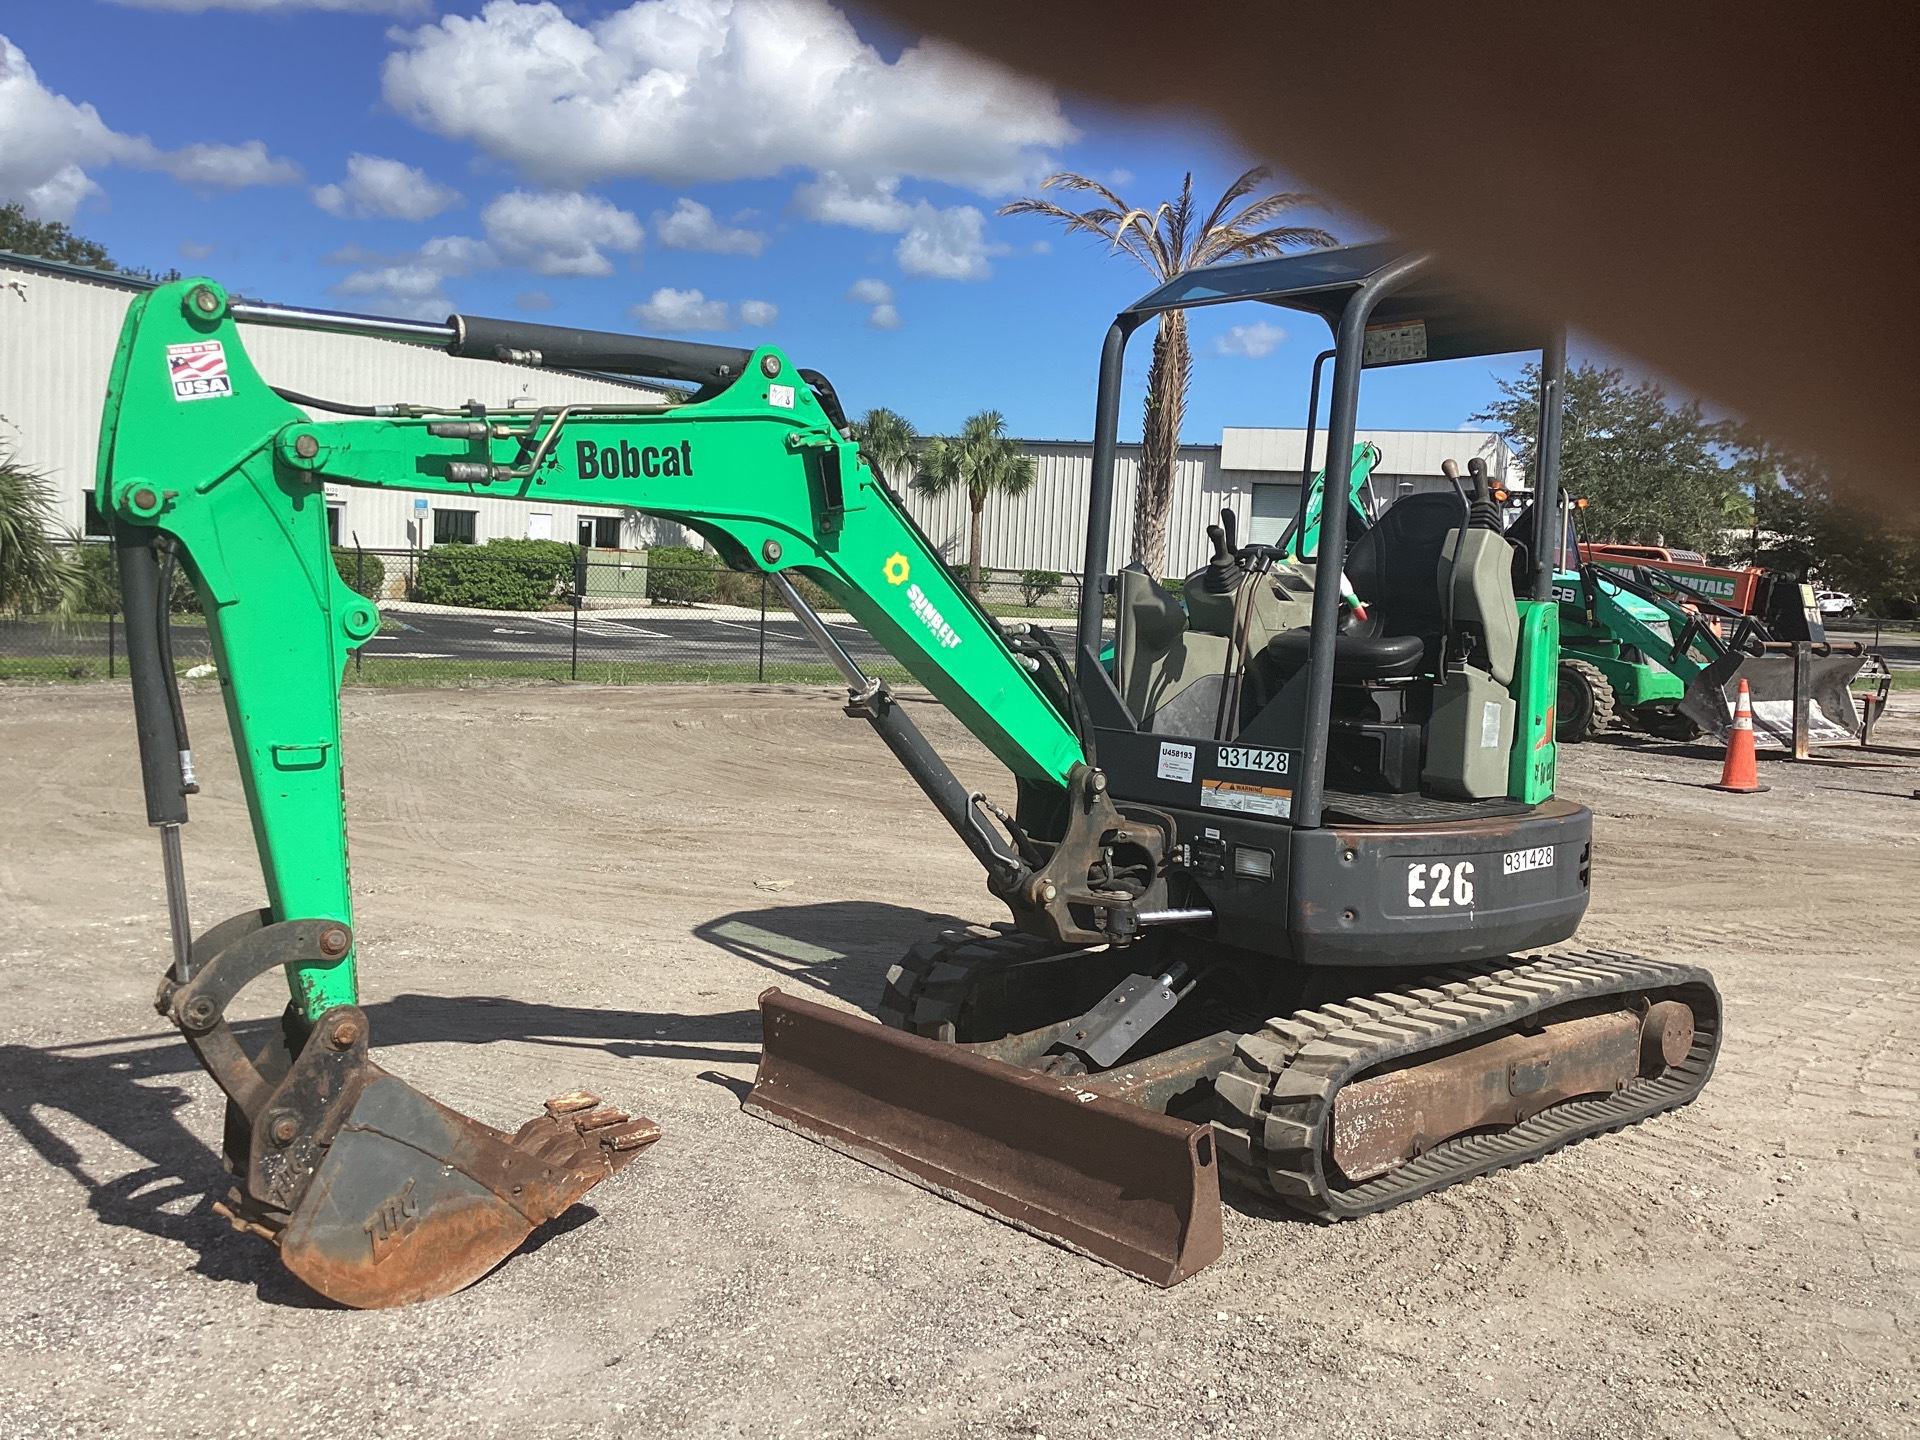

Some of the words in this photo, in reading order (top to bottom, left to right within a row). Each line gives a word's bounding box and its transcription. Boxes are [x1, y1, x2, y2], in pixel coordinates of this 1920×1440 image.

[169, 347, 192, 355] MADE
[194, 345, 203, 353] IN
[204, 344, 219, 352] THE
[177, 378, 227, 395] USA
[576, 440, 693, 480] Bobcat
[1552, 586, 1576, 603] CB
[906, 583, 963, 649] SUNBELT
[908, 602, 947, 648] RENTALS
[1162, 748, 1192, 760] U458193
[1219, 747, 1287, 772] 931428
[1236, 784, 1263, 794] WARNING
[1505, 847, 1552, 872] 931428
[1408, 861, 1475, 908] E26
